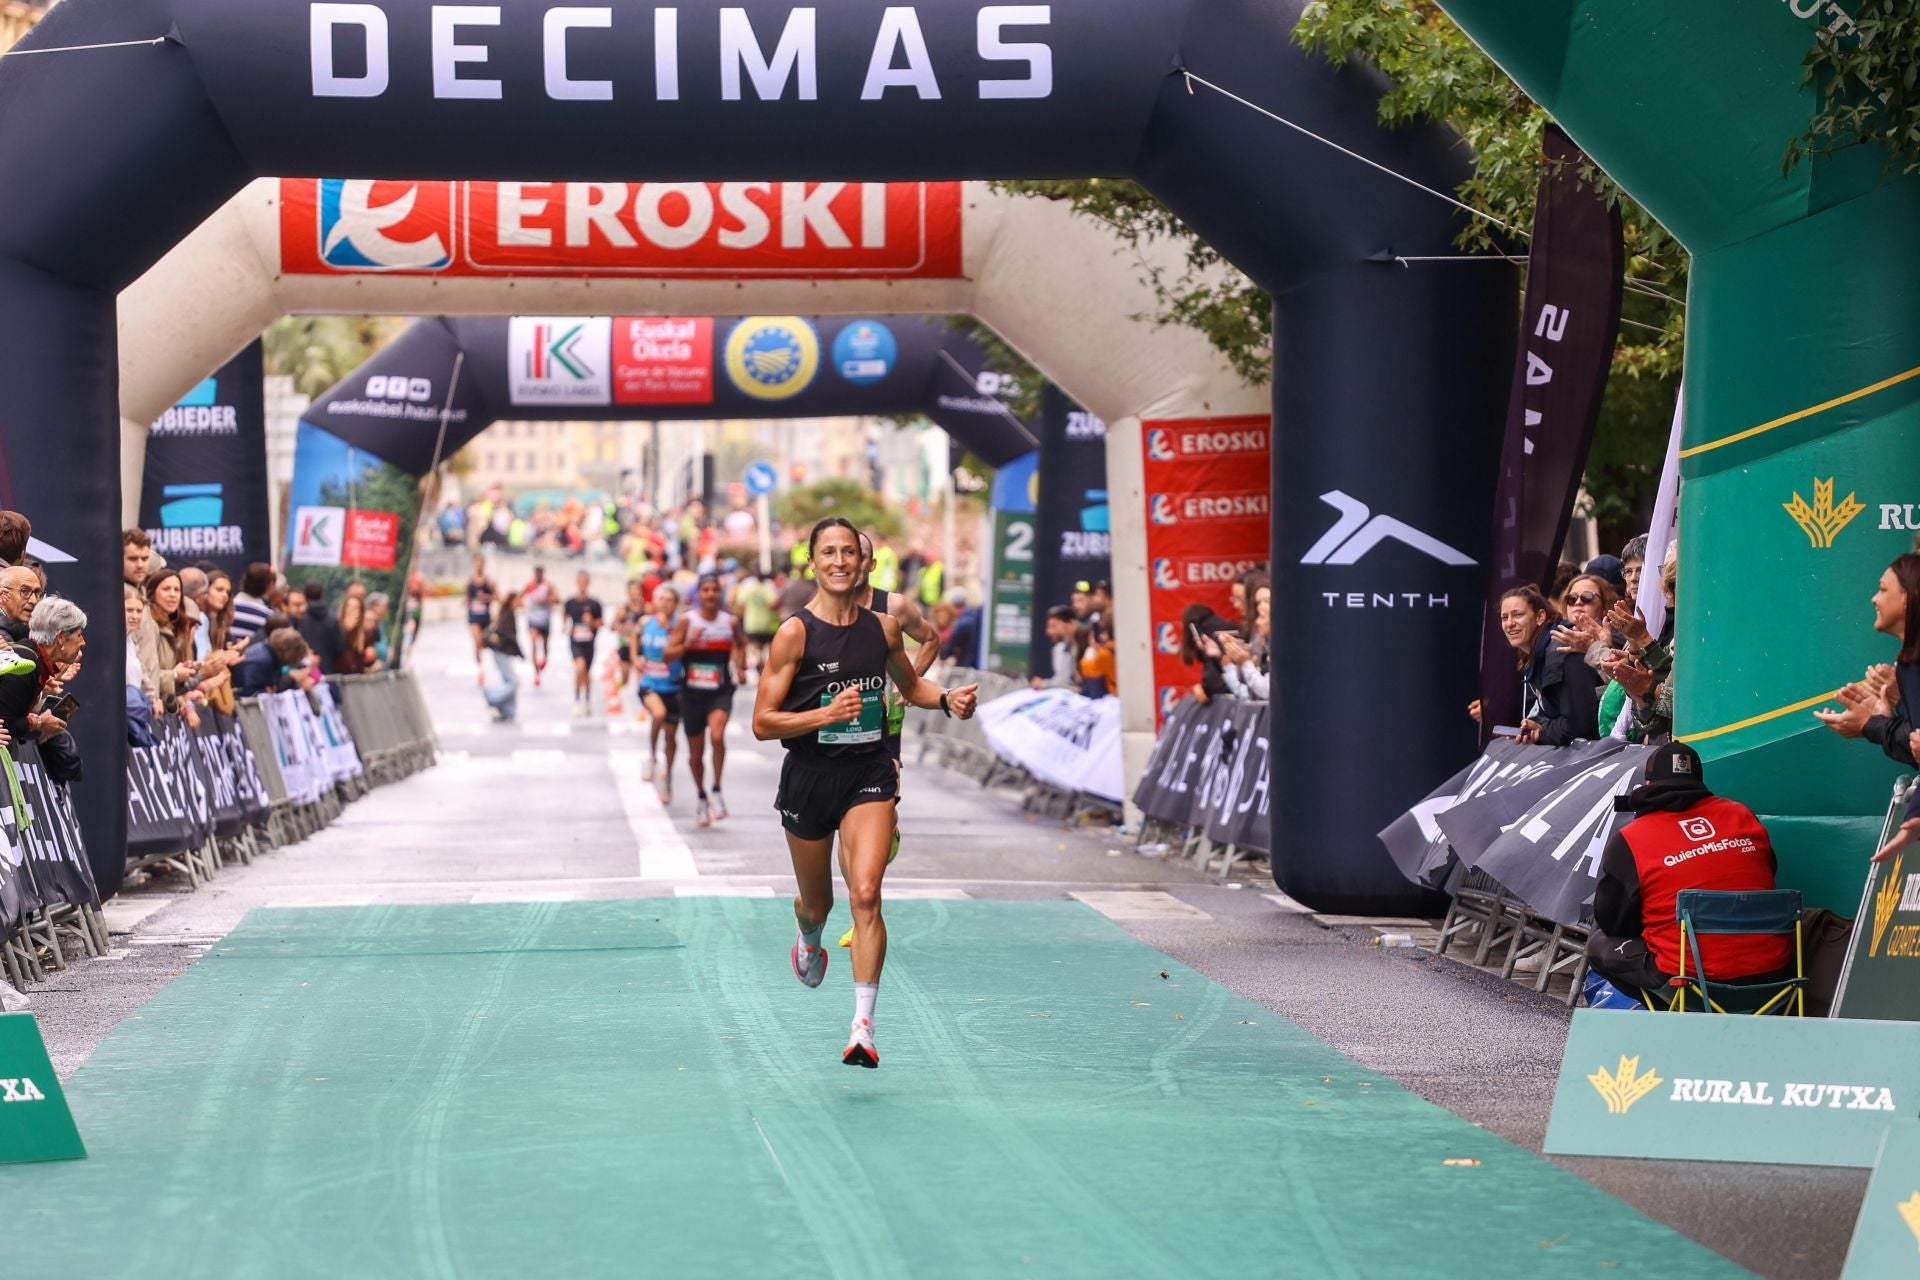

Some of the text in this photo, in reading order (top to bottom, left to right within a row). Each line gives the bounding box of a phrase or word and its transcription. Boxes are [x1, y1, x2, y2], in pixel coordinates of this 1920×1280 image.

[309, 3, 1054, 100] DECIMAS
[496, 181, 886, 250] EROSKI
[629, 320, 696, 339] Euskal
[632, 340, 693, 361] Okela
[151, 405, 238, 431] UBIEDER
[1181, 430, 1265, 454] EROSKI
[1184, 494, 1268, 518] EROSKI
[146, 525, 244, 550] ZUBIEDER
[1004, 521, 1035, 560] 2
[1187, 559, 1257, 582] EROS
[1322, 592, 1449, 608] TENTH
[827, 676, 883, 693] OYSHO
[1663, 838, 1753, 867] QuieroMisFotos
[1741, 844, 1757, 853] .com
[1669, 1078, 1897, 1111] RURAL KUTXA
